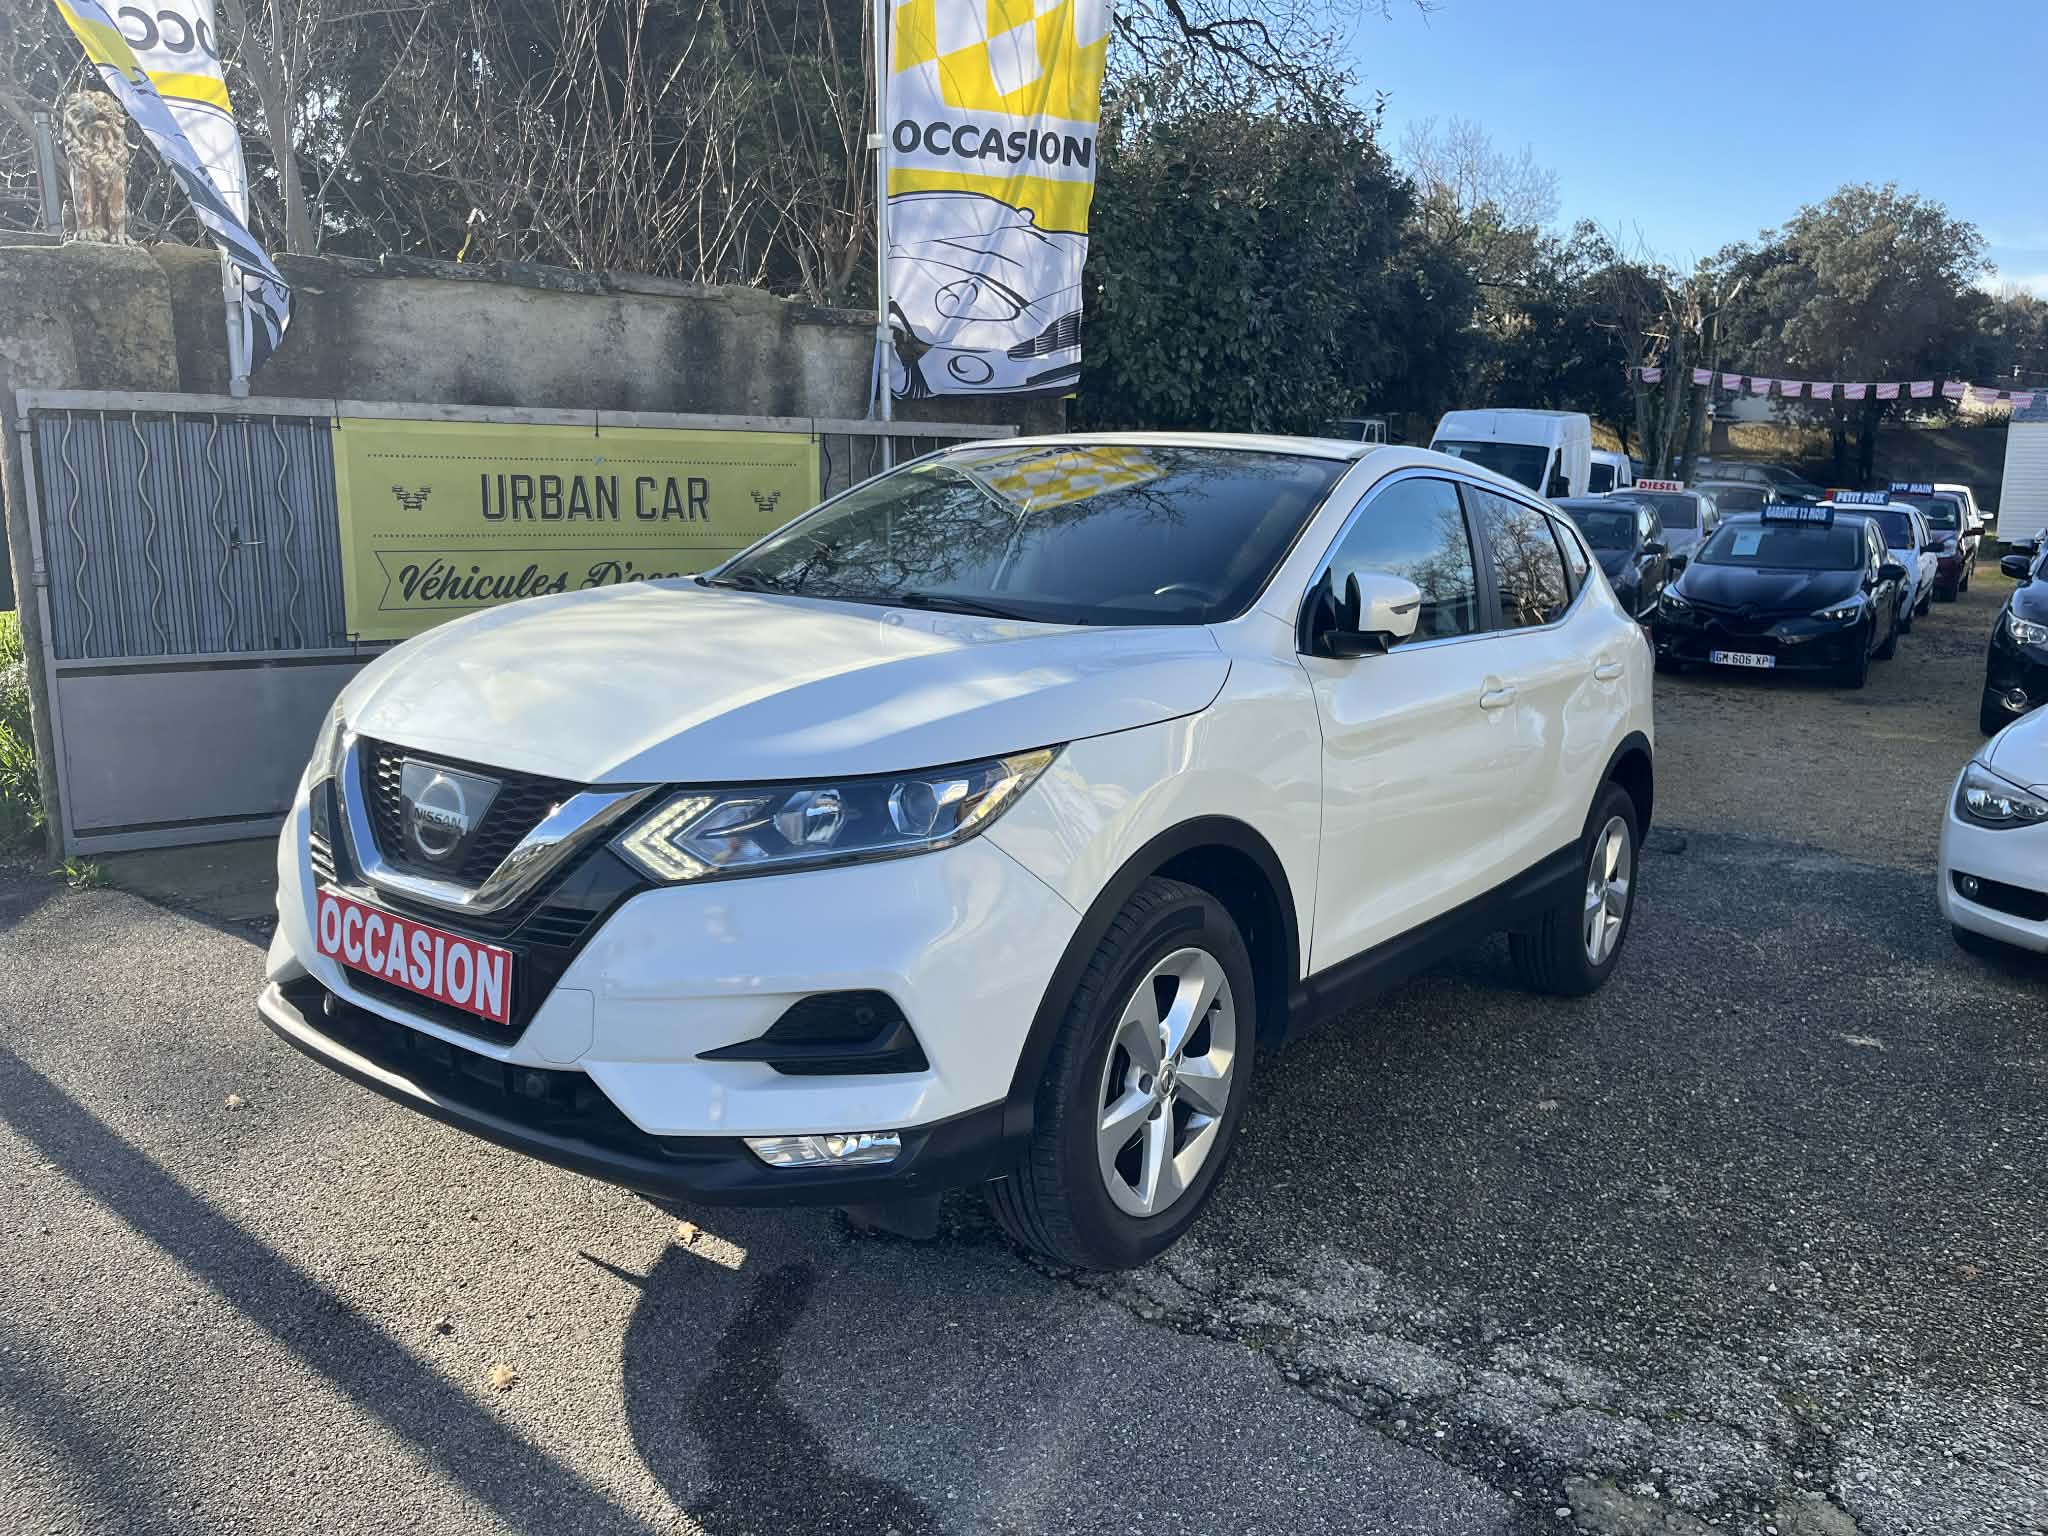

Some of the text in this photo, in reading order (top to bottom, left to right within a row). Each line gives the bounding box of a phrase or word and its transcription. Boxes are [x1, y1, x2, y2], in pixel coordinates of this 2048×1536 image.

[892, 119, 1091, 169] OCCASION
[1639, 480, 1679, 492] DIESEL
[1909, 483, 1932, 494] MAIN
[480, 473, 710, 522] URBAN CAR
[1836, 491, 1885, 505] PETIT PRIX
[1766, 505, 1800, 519] GARANTIE
[1808, 507, 1827, 521] MOIS
[399, 557, 569, 602] Véhicules
[414, 807, 462, 829] NISSAN
[320, 897, 504, 1017] OCCASION
